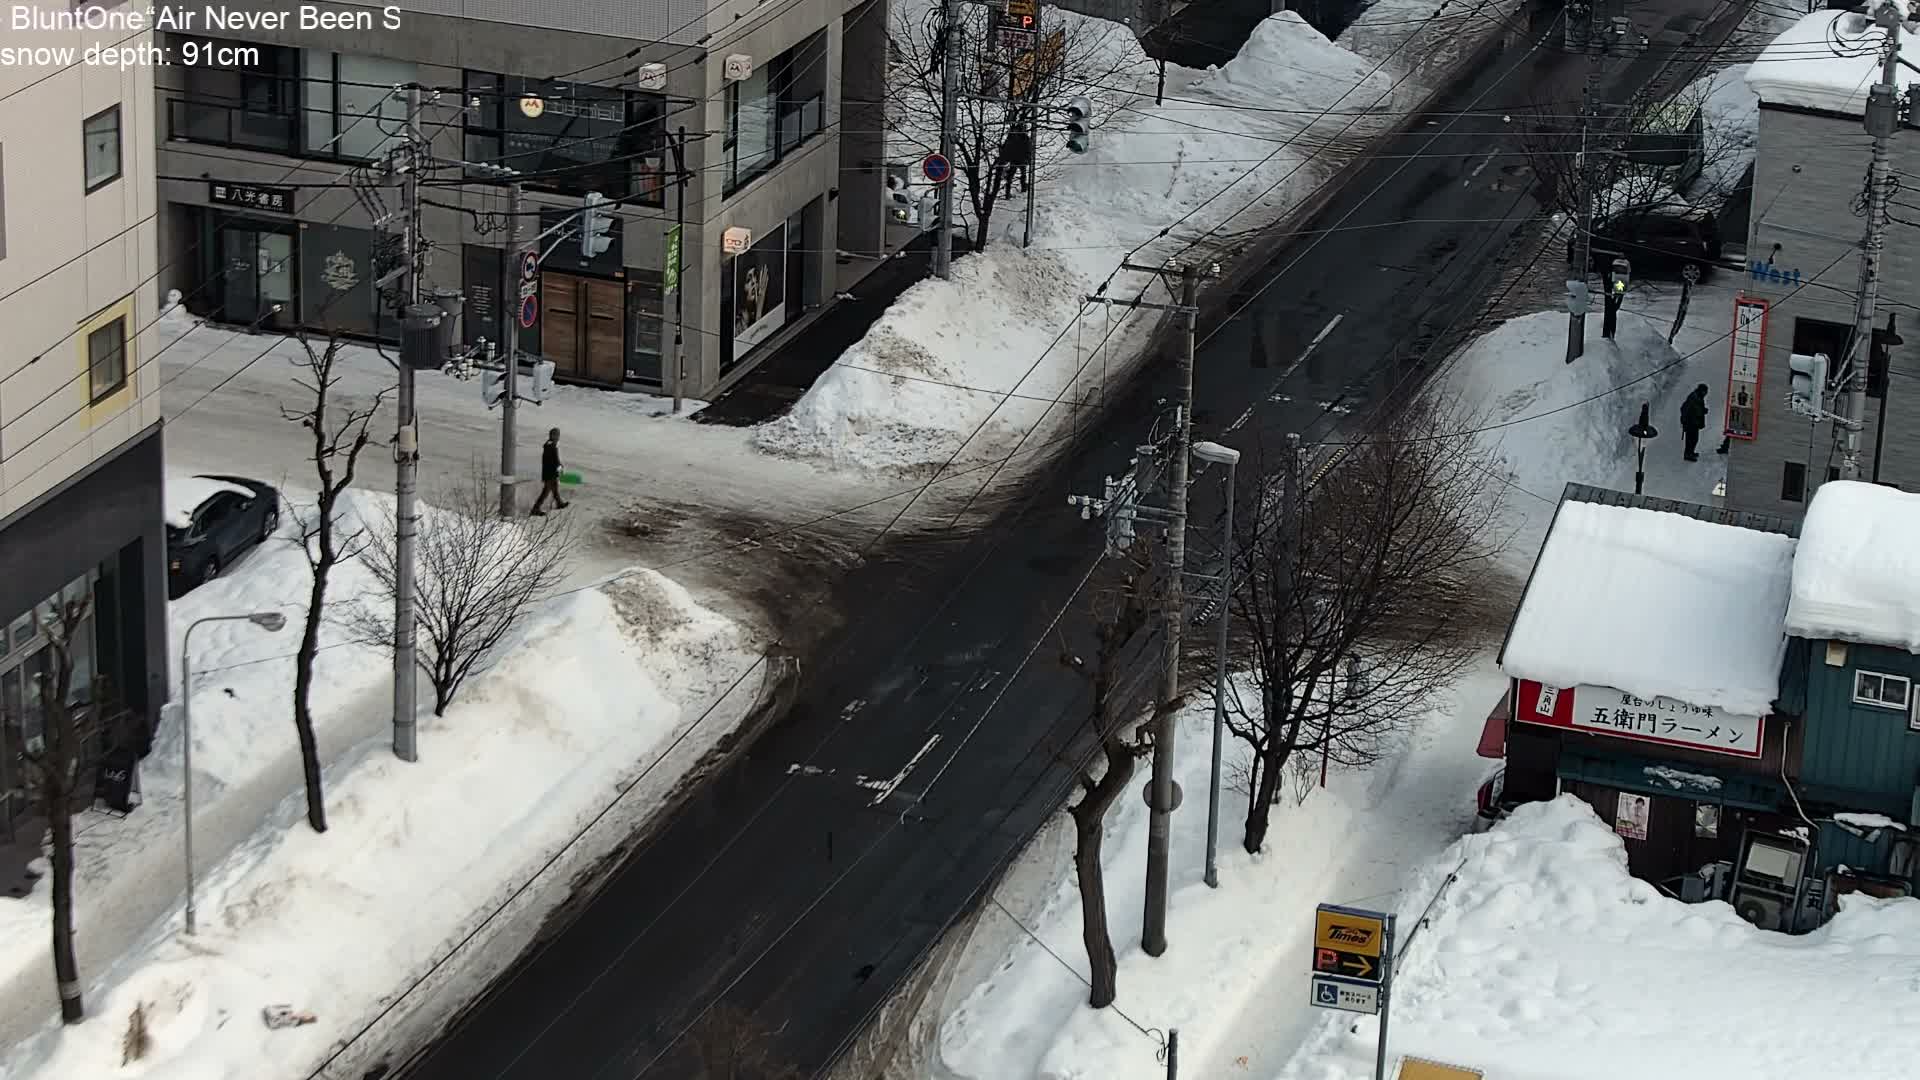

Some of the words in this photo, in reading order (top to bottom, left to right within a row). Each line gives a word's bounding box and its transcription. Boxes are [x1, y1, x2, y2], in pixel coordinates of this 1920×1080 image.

[1022, 15, 1033, 28] P
[1590, 707, 1745, 744] 五衛門ラーメン
[1328, 925, 1374, 944] Times
[1317, 948, 1338, 970] P
